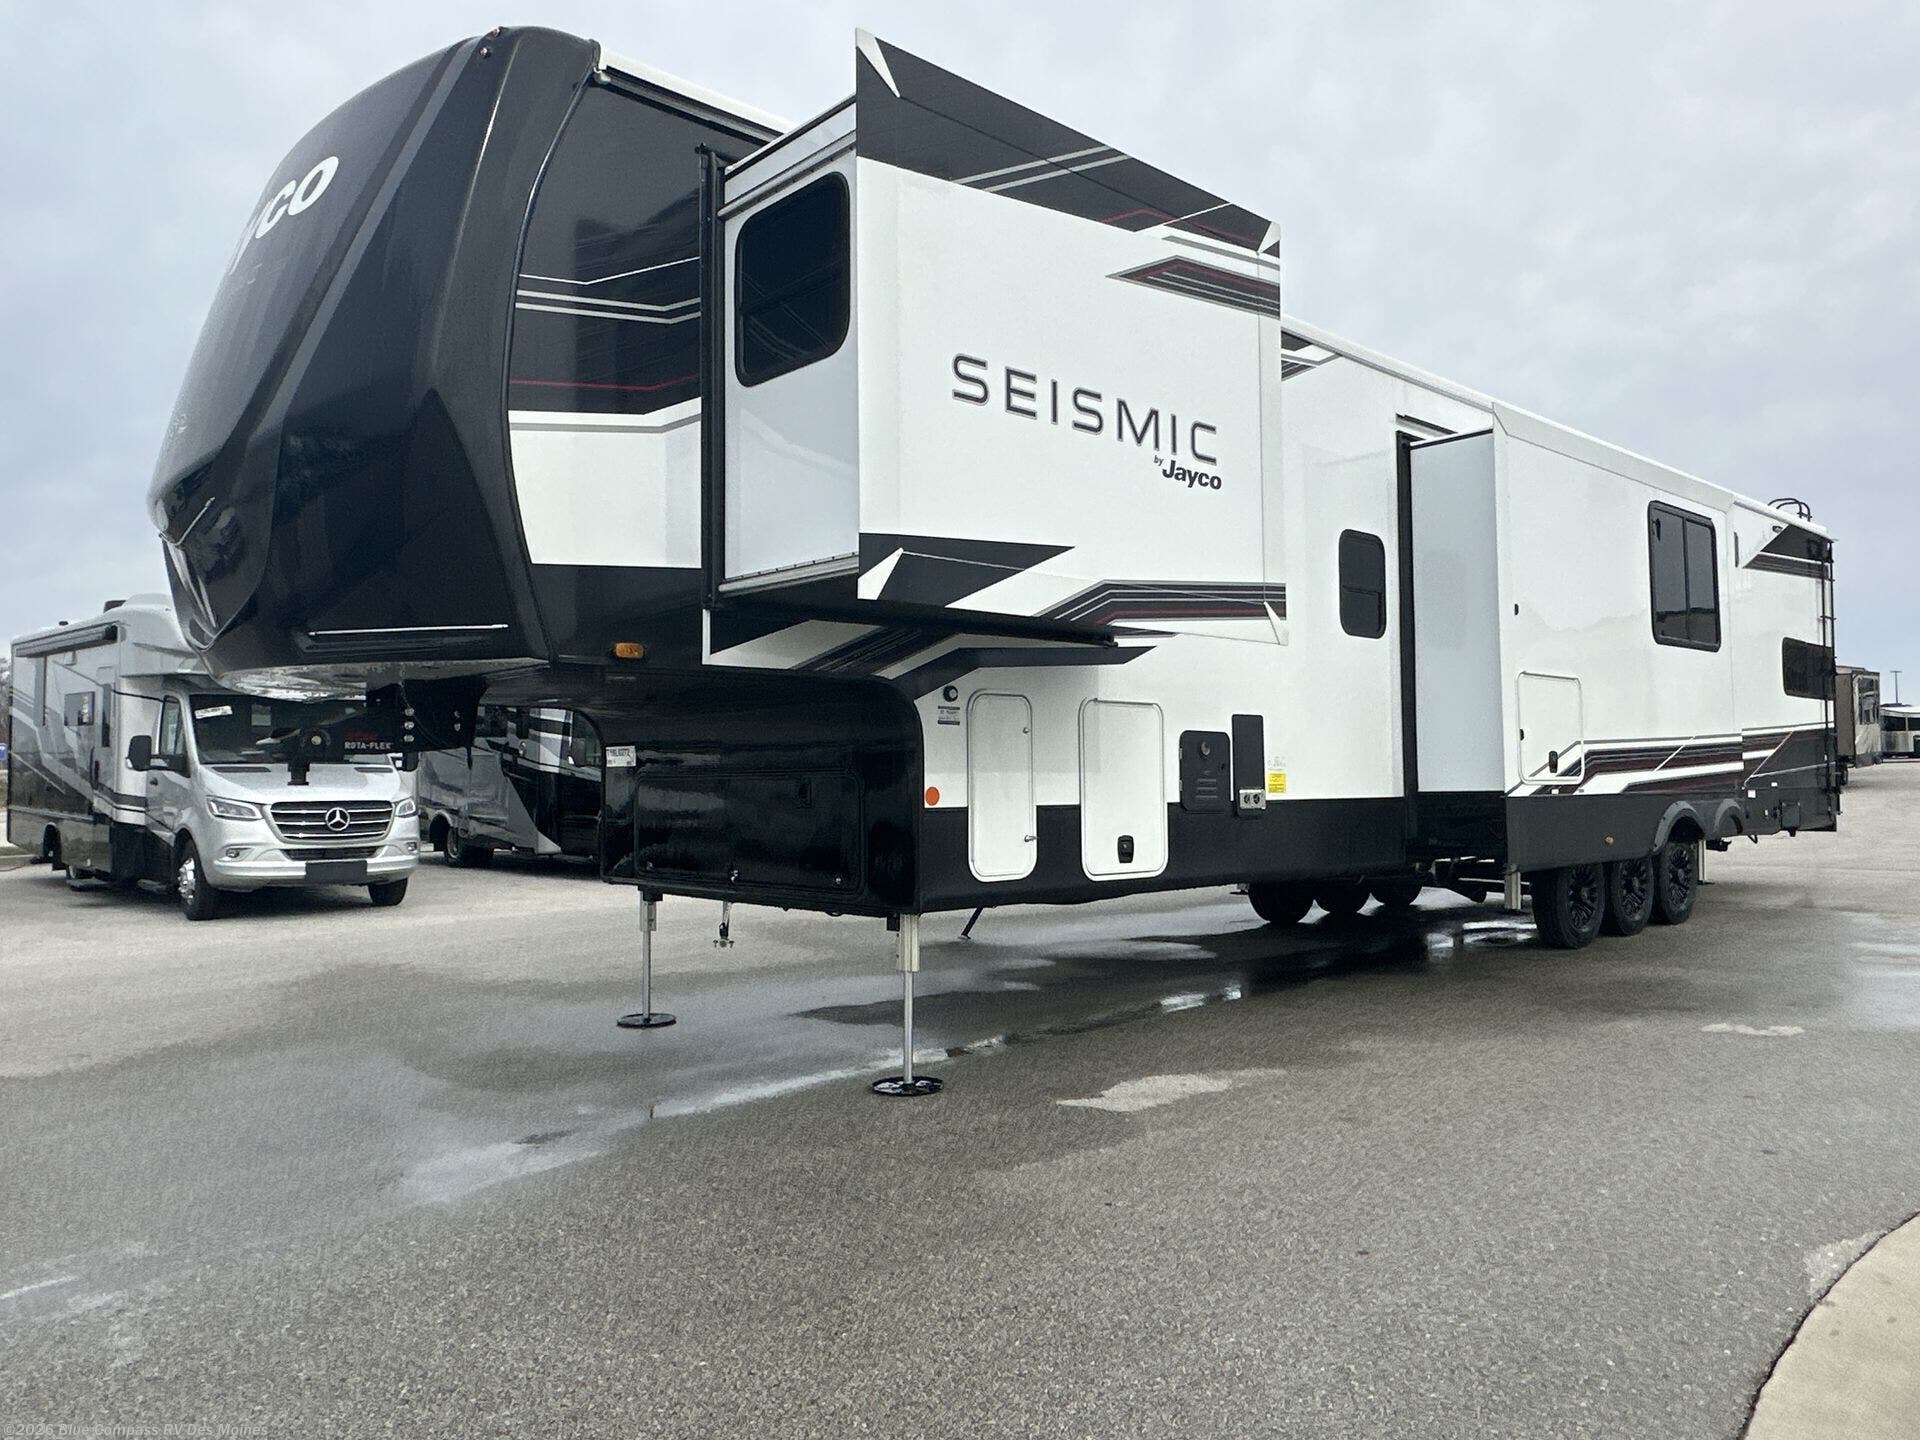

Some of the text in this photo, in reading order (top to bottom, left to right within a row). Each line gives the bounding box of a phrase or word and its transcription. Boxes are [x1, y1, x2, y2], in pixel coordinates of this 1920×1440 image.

[952, 353, 1217, 466] SEISMIC
[1153, 455, 1222, 490] by Jayco
